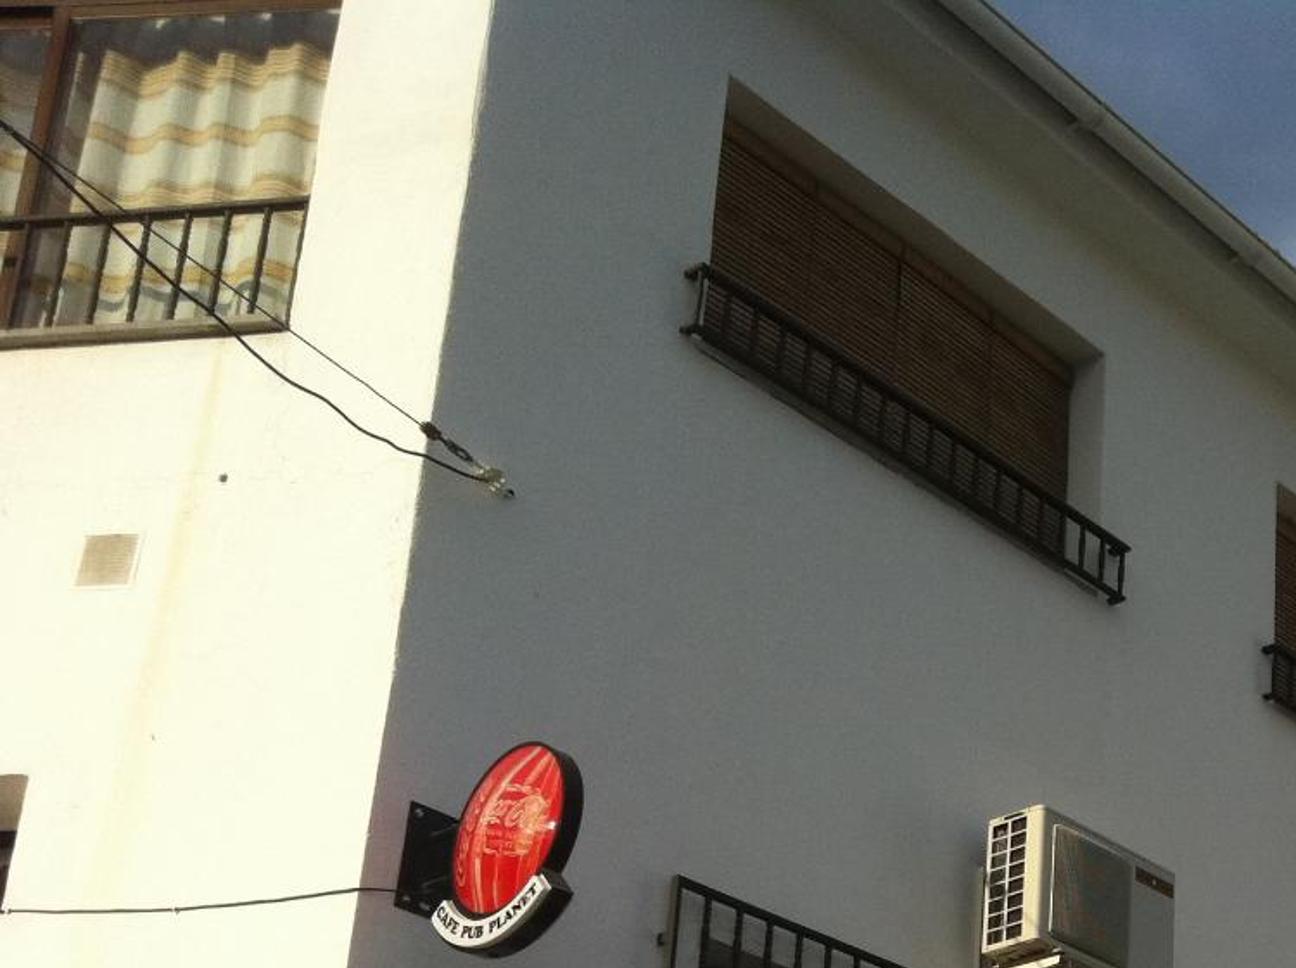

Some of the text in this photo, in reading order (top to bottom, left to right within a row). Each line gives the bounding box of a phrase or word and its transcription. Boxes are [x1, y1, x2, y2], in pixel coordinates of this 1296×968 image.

[437, 882, 537, 939] CAFE PUB PLANET
